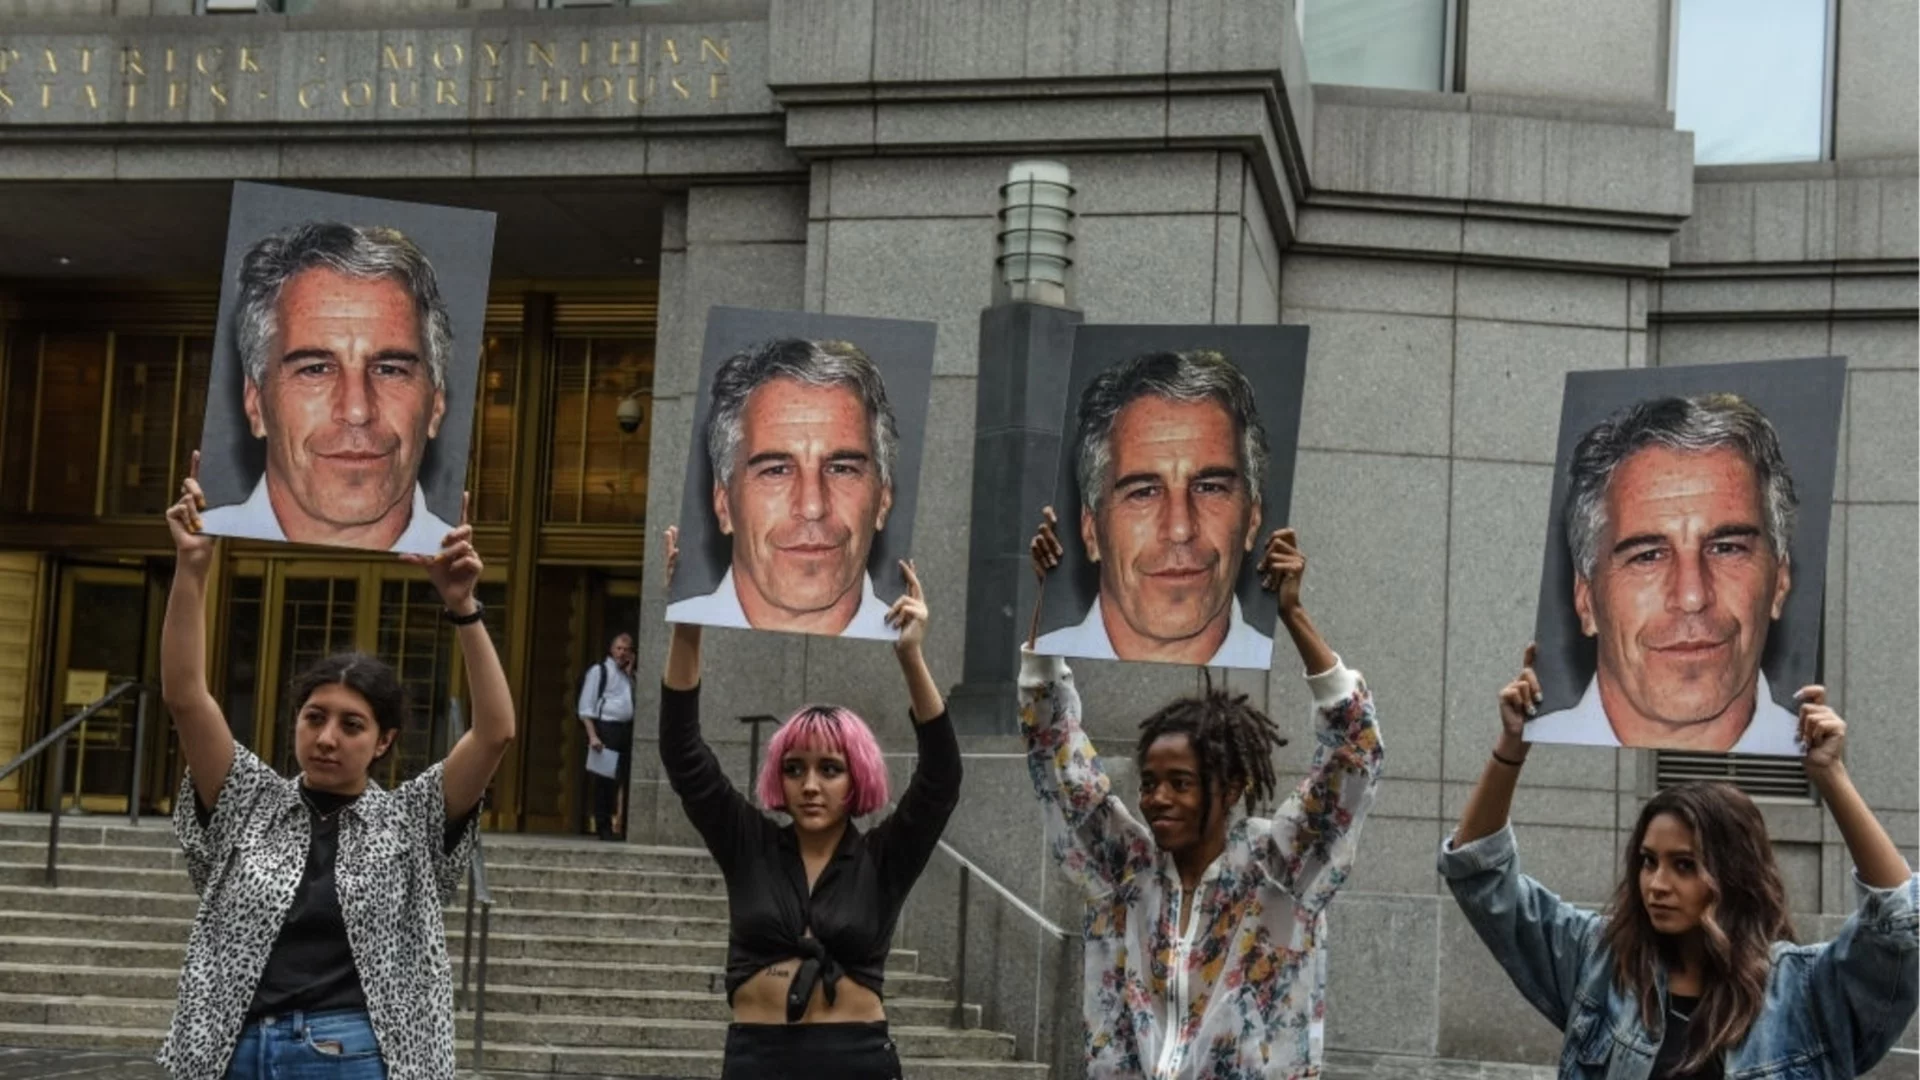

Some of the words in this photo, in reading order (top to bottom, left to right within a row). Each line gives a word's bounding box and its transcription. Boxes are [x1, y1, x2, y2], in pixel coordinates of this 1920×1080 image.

[0, 47, 262, 75] PATRICK
[384, 38, 730, 71] MOYNIHAN
[299, 77, 502, 108] COURT
[540, 72, 729, 103] HOUSE
